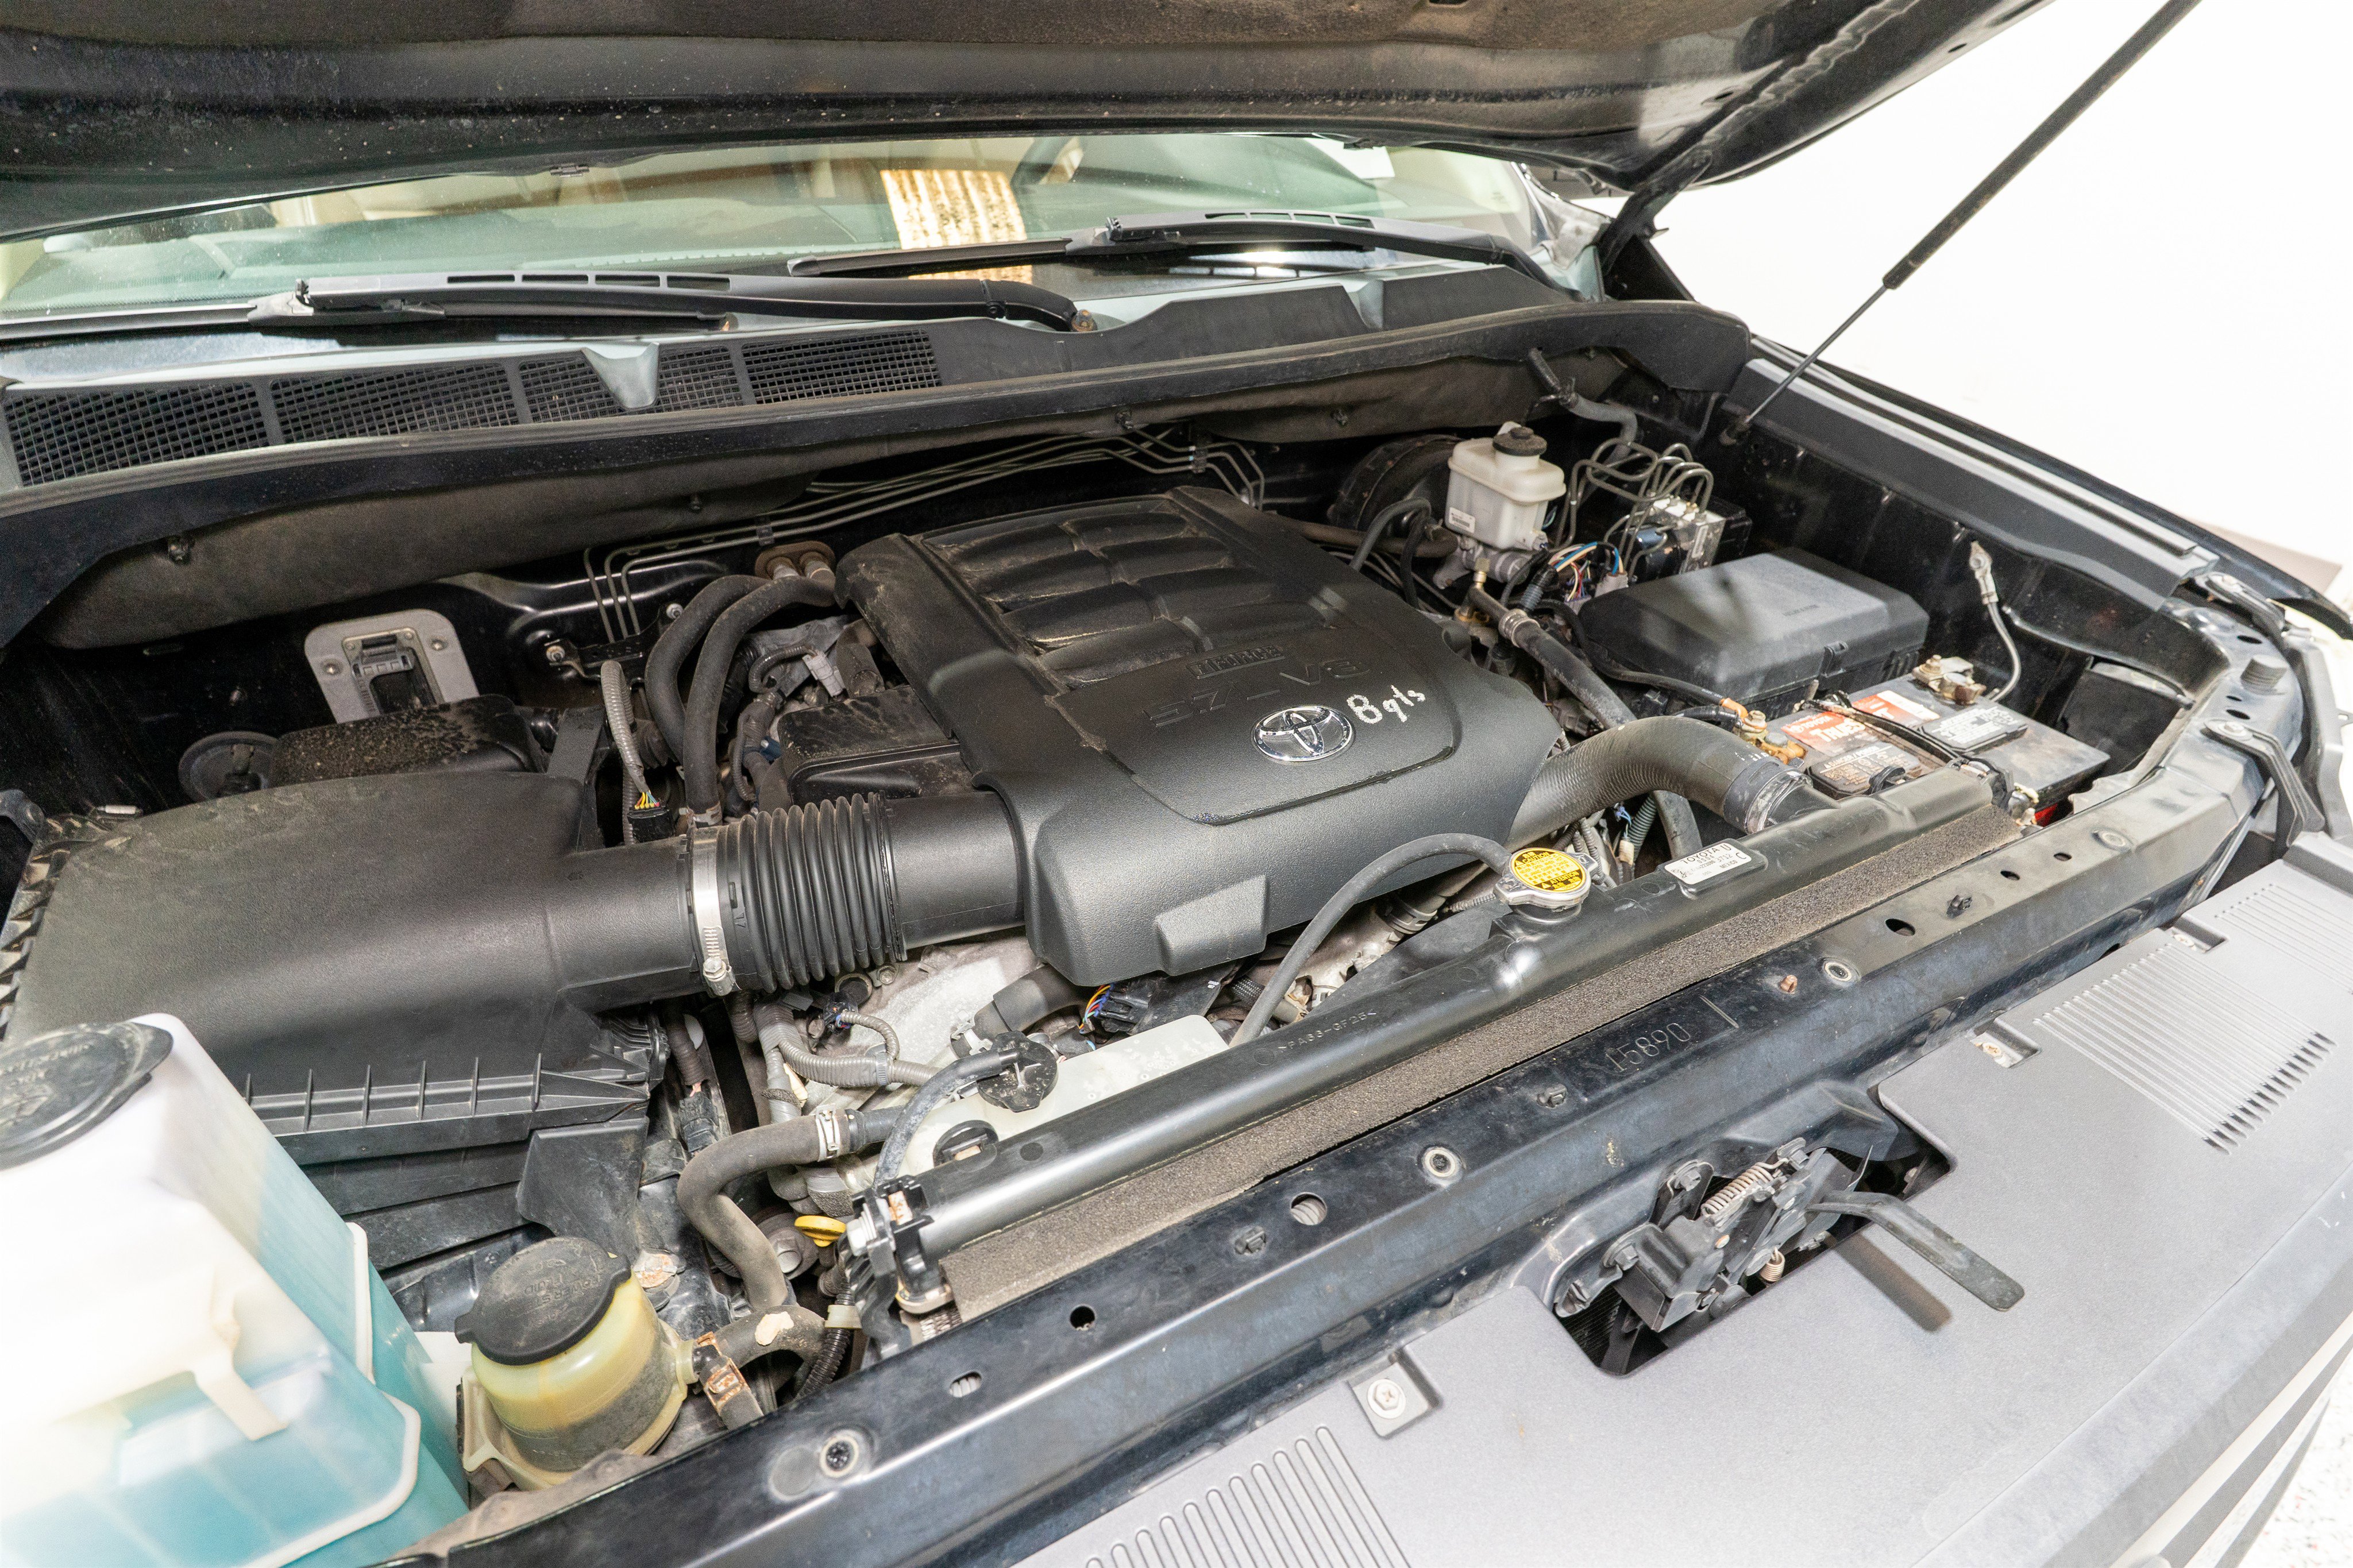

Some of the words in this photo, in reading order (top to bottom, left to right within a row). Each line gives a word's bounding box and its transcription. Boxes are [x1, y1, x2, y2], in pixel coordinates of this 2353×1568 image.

[1279, 658, 1370, 686] V8
[1522, 852, 1550, 864] CAUTION
[1680, 848, 1720, 864] TOYOTA
[1716, 853, 1733, 863] 3712
[1735, 852, 1747, 860] C
[1719, 860, 1738, 869] MEXICO
[1550, 871, 1580, 885] ATTENTION
